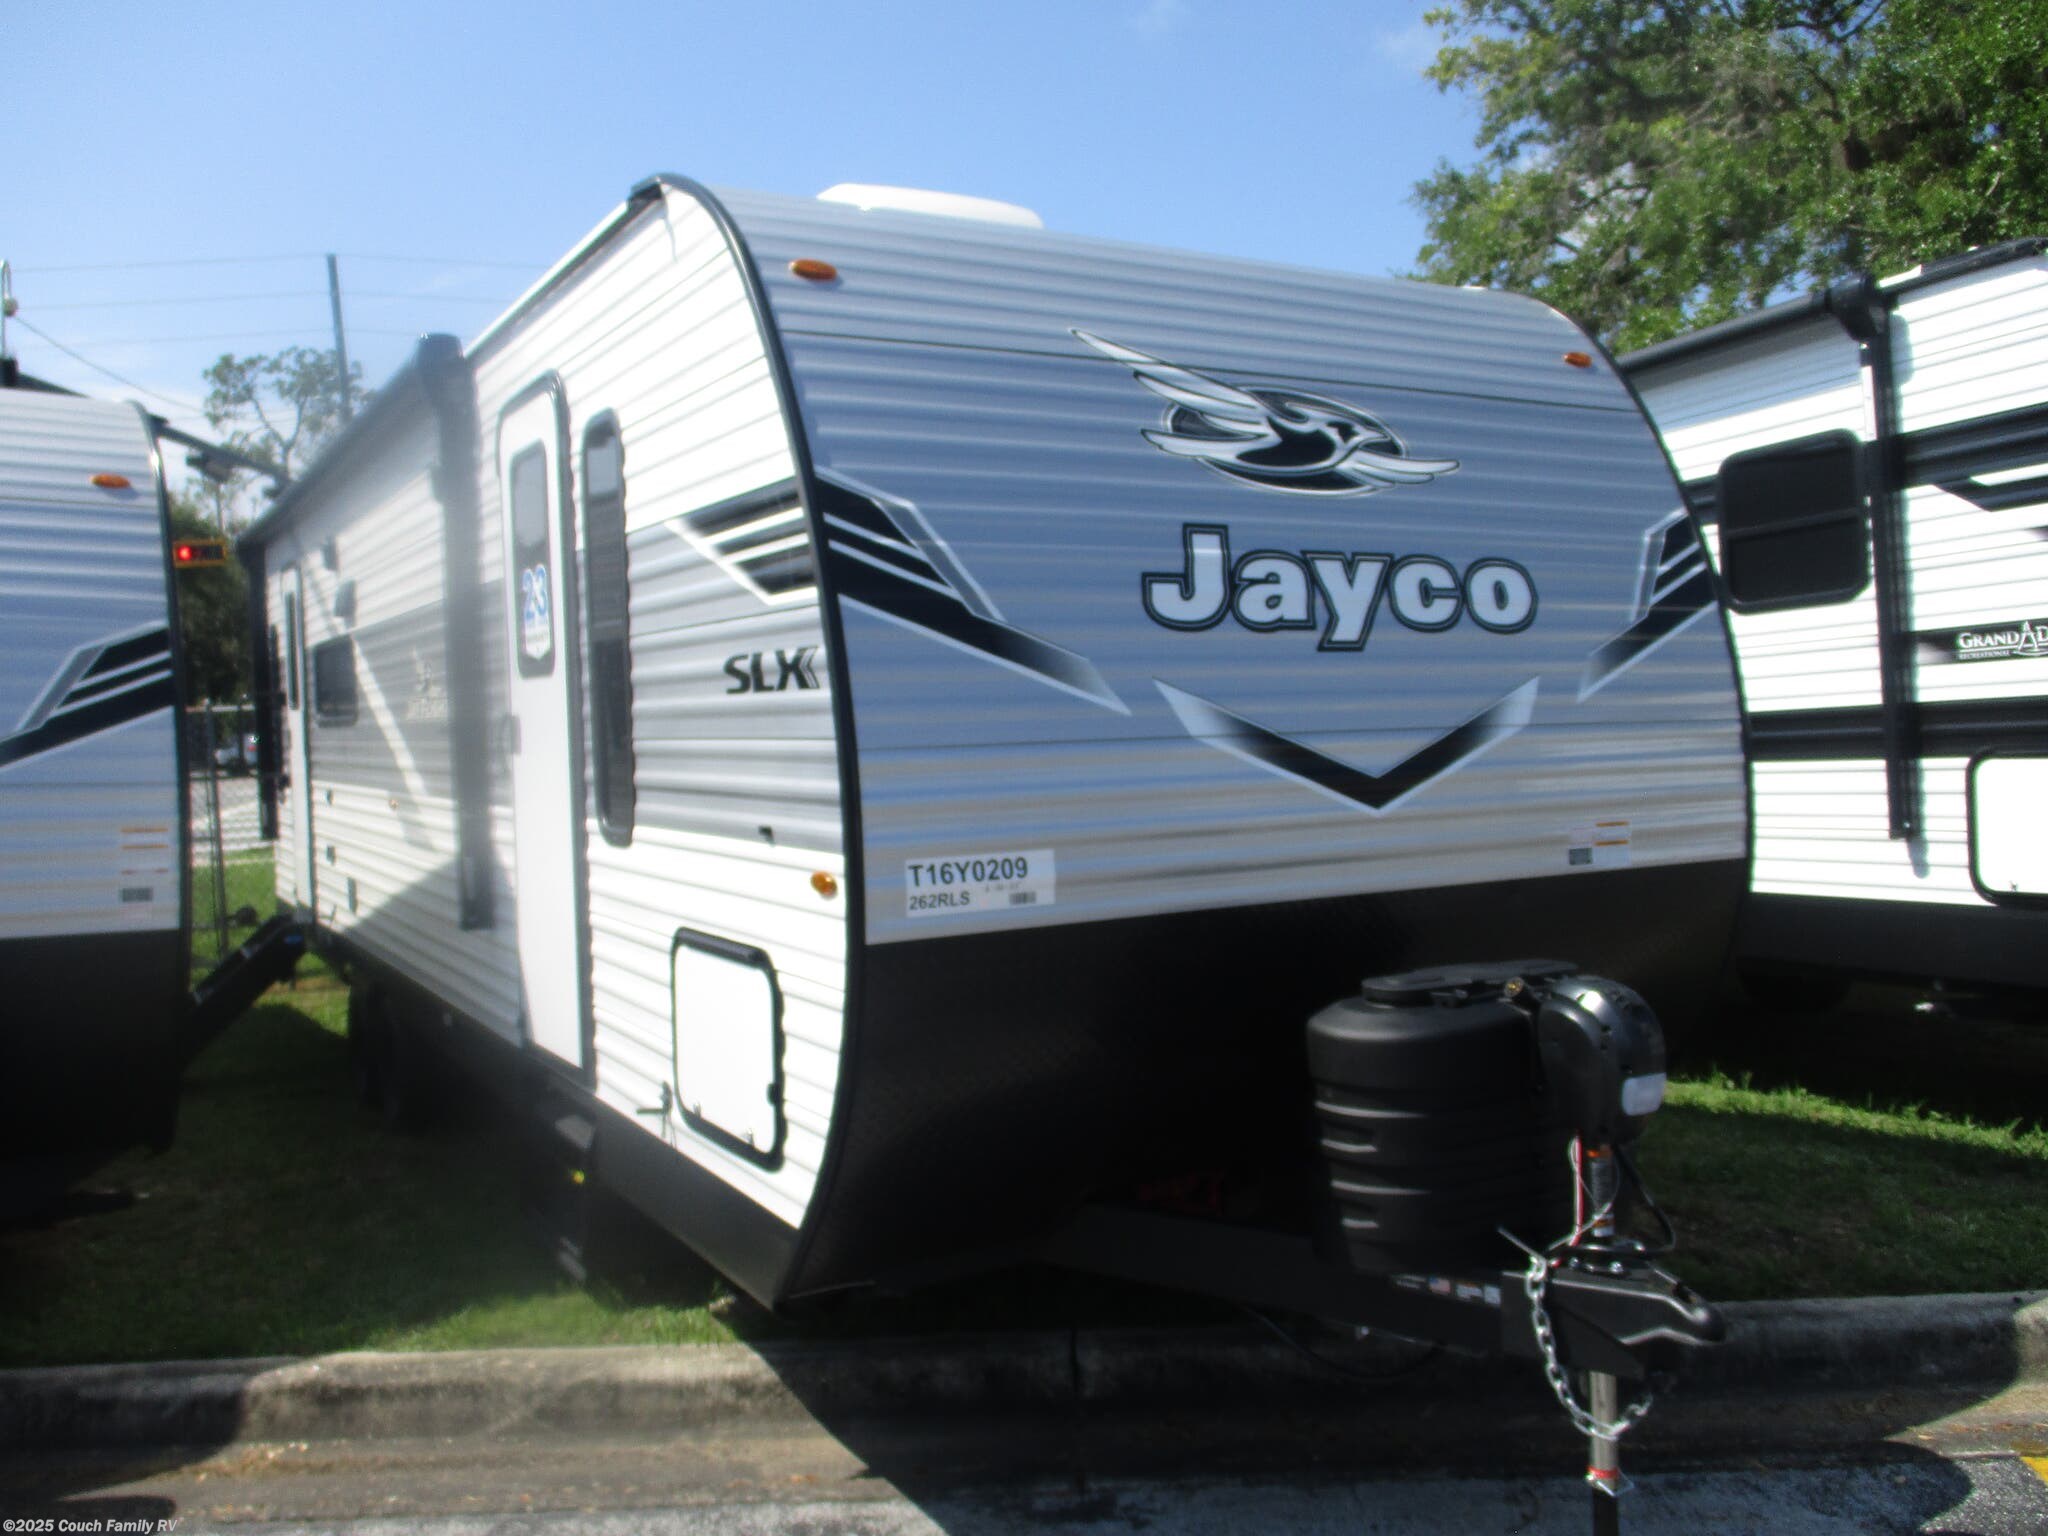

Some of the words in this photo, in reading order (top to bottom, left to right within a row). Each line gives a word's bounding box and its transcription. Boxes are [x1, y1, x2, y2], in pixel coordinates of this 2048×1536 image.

[1142, 523, 1538, 651] Jayco
[723, 645, 820, 694] SLX
[908, 856, 1028, 887] T16Y0209
[909, 891, 971, 910] 262RLS
